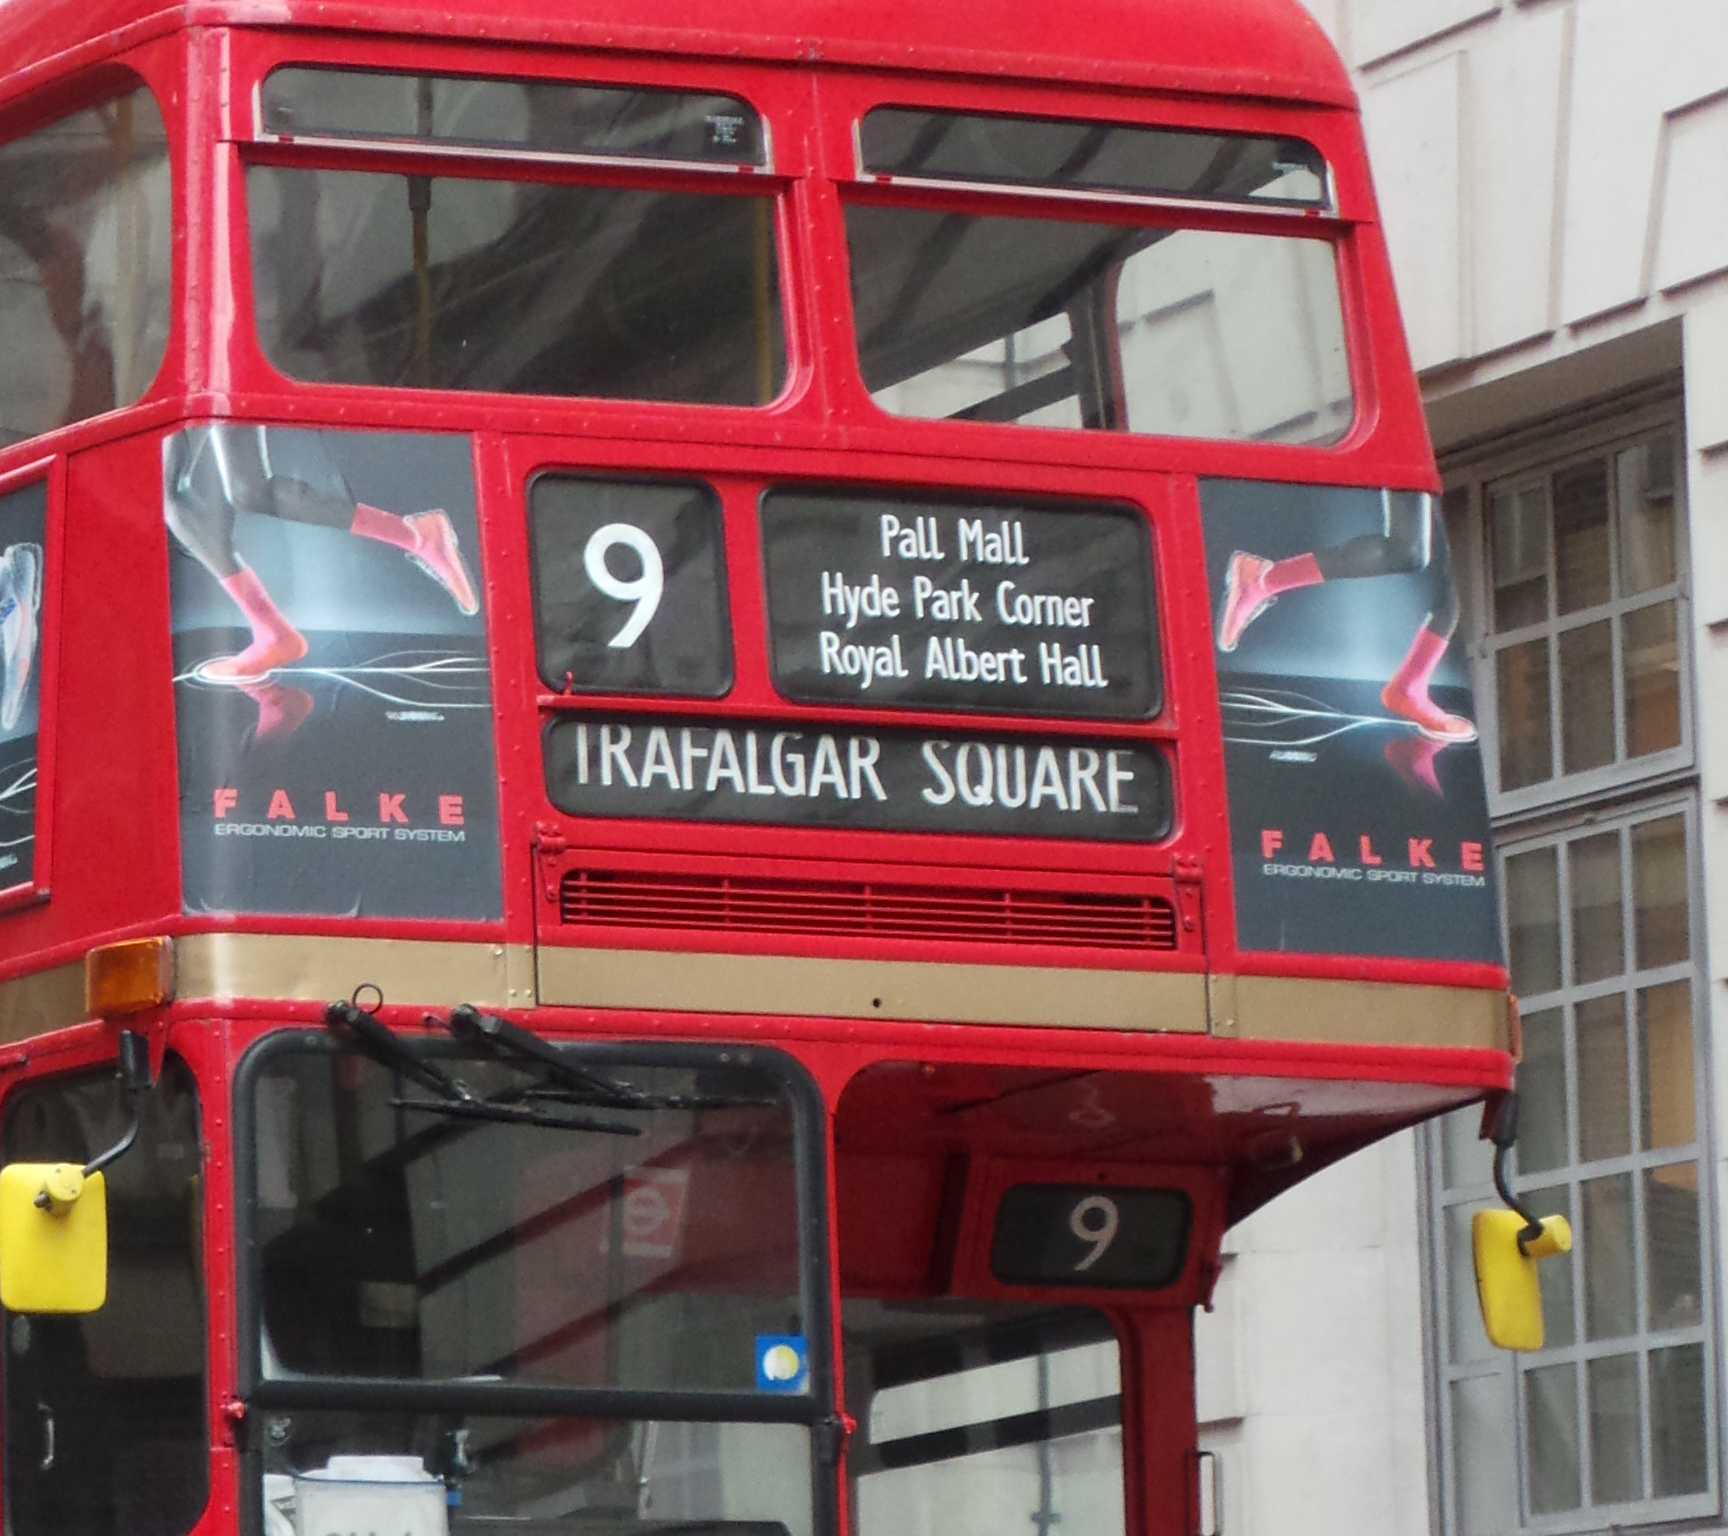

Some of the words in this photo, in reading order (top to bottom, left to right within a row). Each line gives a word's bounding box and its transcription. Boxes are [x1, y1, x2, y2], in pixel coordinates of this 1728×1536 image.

[880, 514, 944, 561] Pall
[959, 518, 1029, 565] Mall
[583, 522, 664, 648] 9
[821, 571, 899, 628] Hyde
[914, 576, 981, 622] Park
[996, 581, 1093, 627] Corner
[819, 632, 908, 689] Royal
[925, 636, 1026, 685] Albert
[1040, 642, 1108, 689] Hall
[921, 740, 1139, 815] SQUARE
[212, 787, 465, 826] FALKE
[213, 823, 327, 839] ERGONOMIC
[332, 826, 390, 840] SPORT
[394, 828, 466, 843] SYSTEM
[1261, 828, 1486, 872] FALKE
[1263, 864, 1362, 882] ERGONOMIC
[1366, 869, 1418, 883] SPORT
[1423, 872, 1486, 888] SYSTEM
[1069, 1195, 1119, 1271] 9
